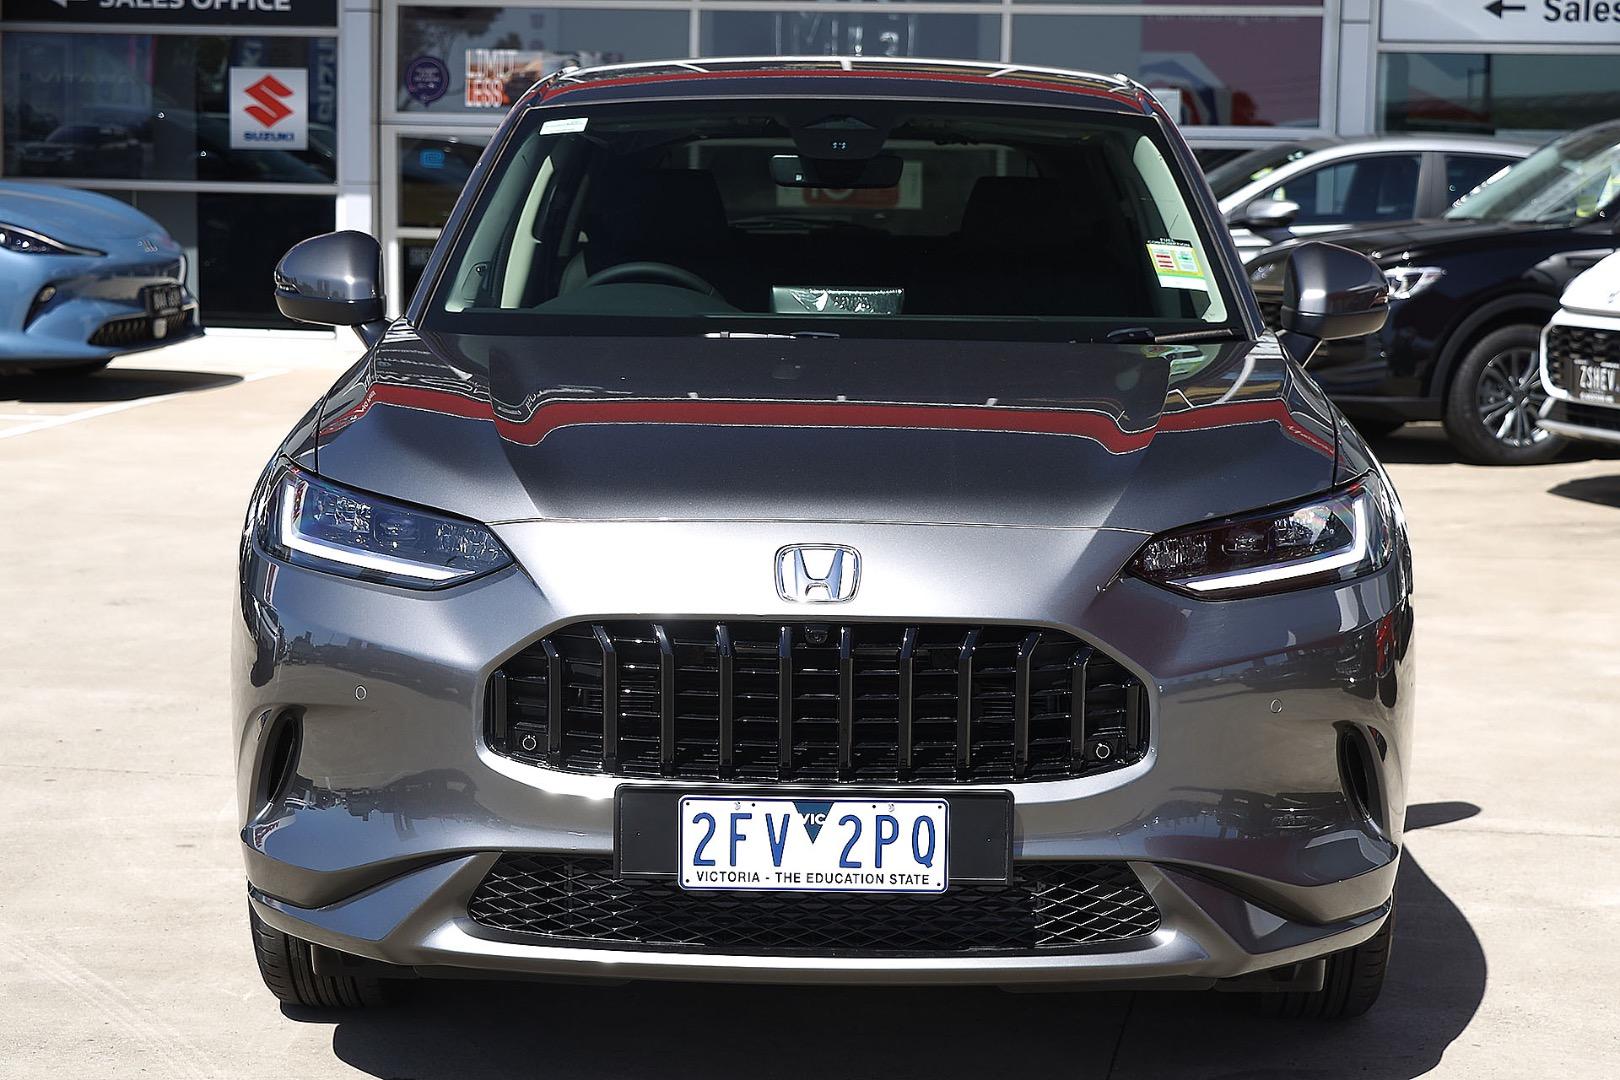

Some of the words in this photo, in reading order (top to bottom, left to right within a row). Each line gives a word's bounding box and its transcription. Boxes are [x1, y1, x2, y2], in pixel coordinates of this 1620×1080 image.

[465, 79, 503, 107] LESS
[243, 132, 295, 142] SUZUKI
[800, 812, 826, 826] VIC
[692, 812, 790, 867] 2FV
[838, 814, 936, 869] 2PQ
[697, 871, 760, 883] VICTORIA
[776, 872, 801, 884] THE
[806, 872, 884, 885] EDUCATION
[889, 873, 930, 886] STATE
